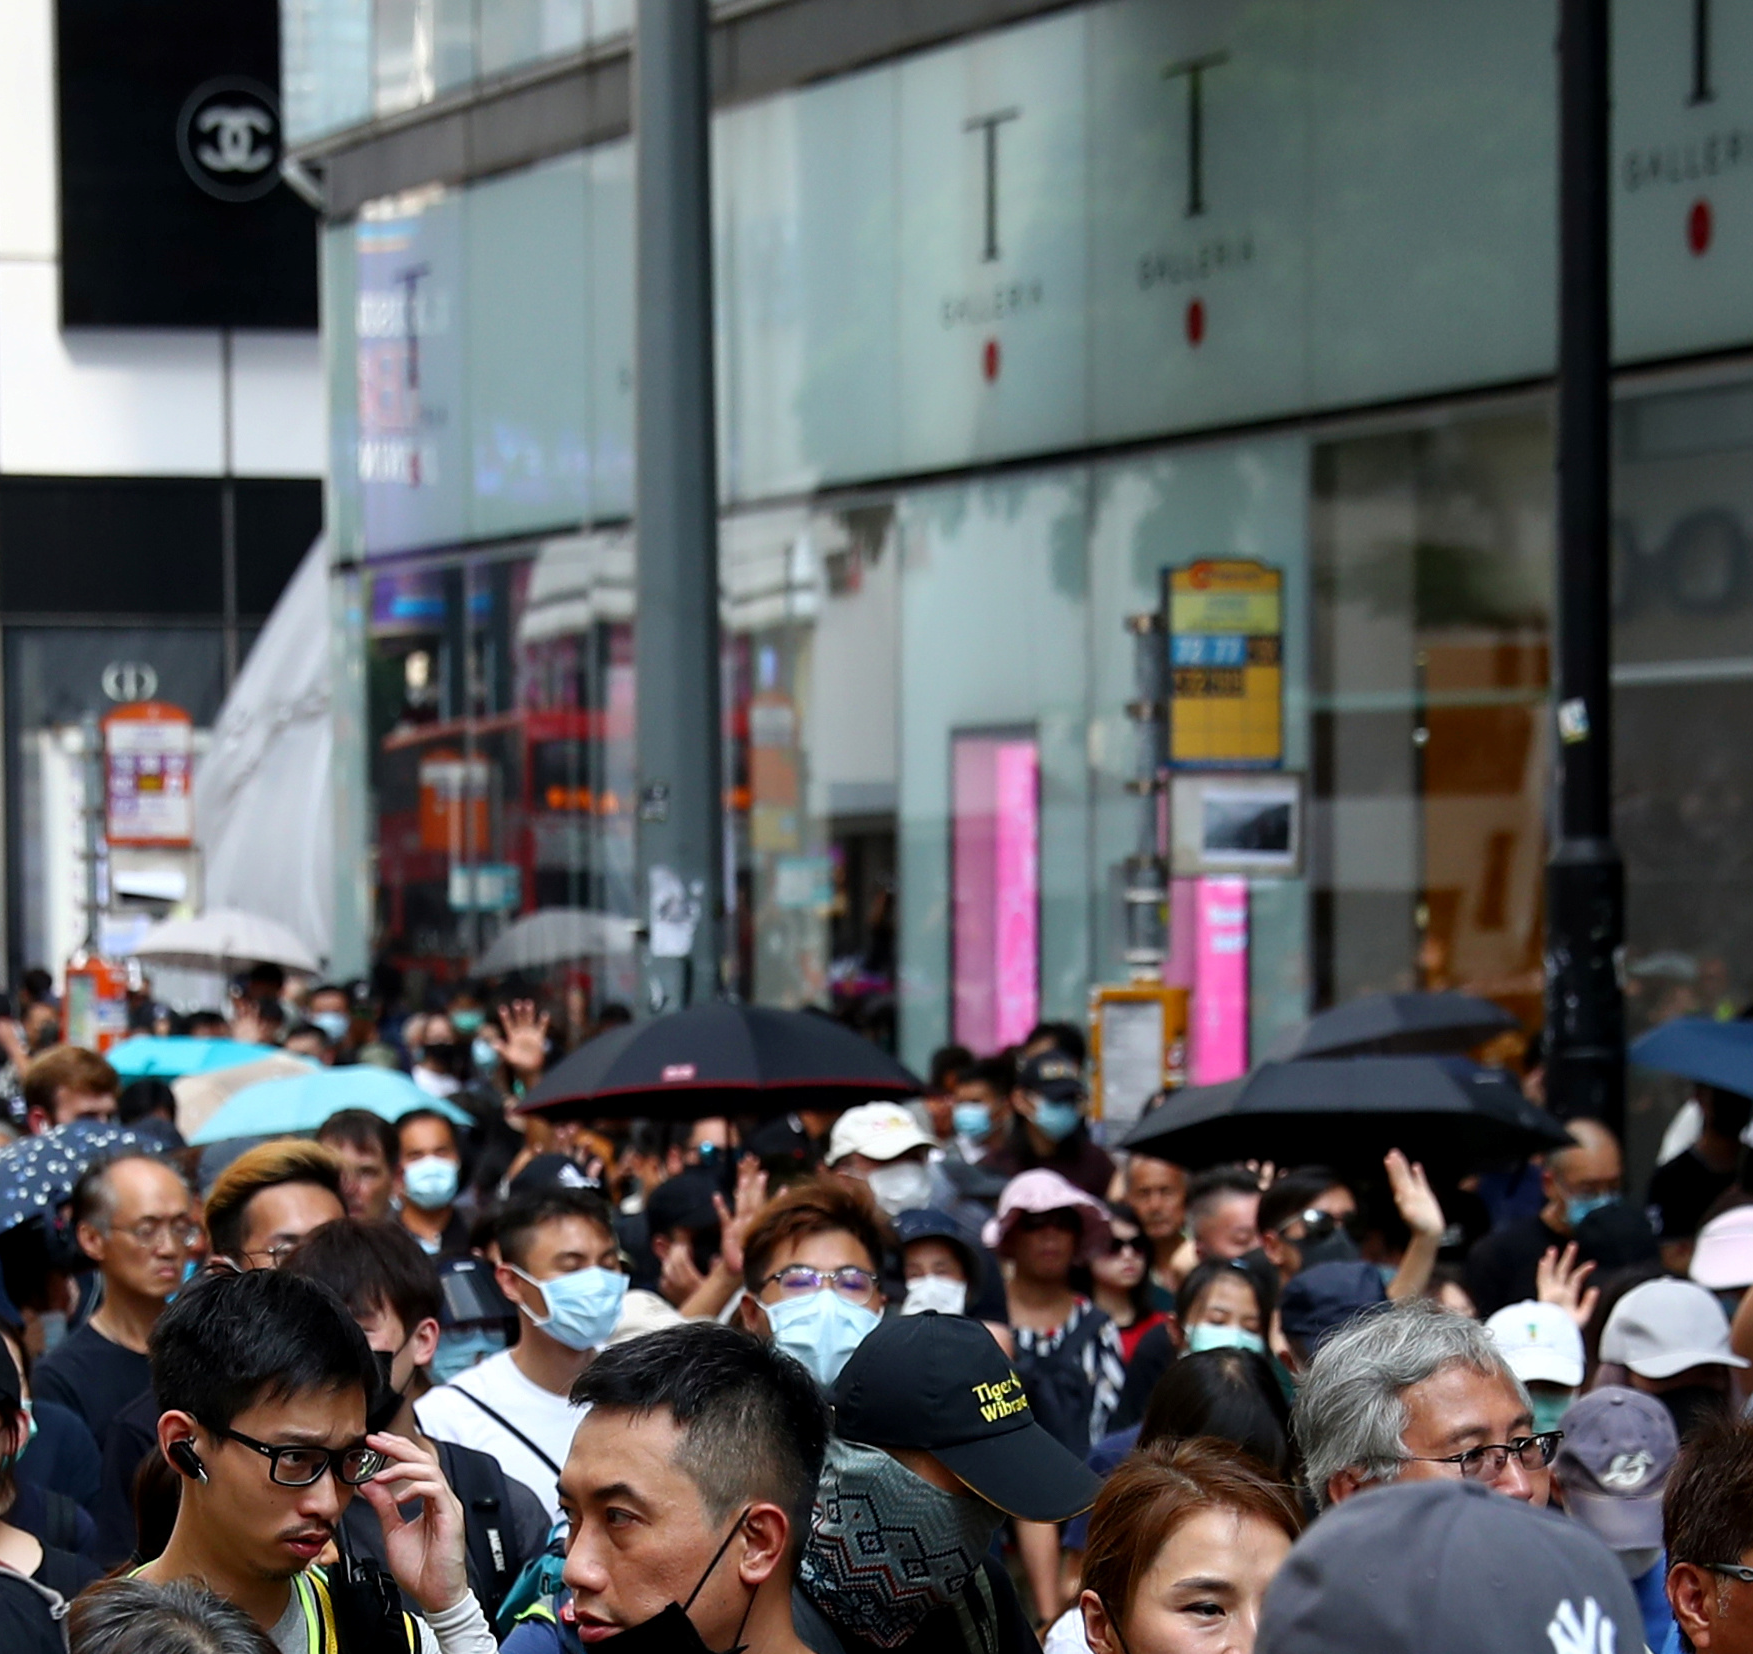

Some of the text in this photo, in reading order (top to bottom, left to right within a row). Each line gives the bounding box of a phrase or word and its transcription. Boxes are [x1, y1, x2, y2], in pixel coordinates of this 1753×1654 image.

[963, 104, 1022, 263] T
[1161, 50, 1230, 217] T
[1138, 237, 1254, 291] GALLERIA
[972, 1379, 1012, 1403] Tiger
